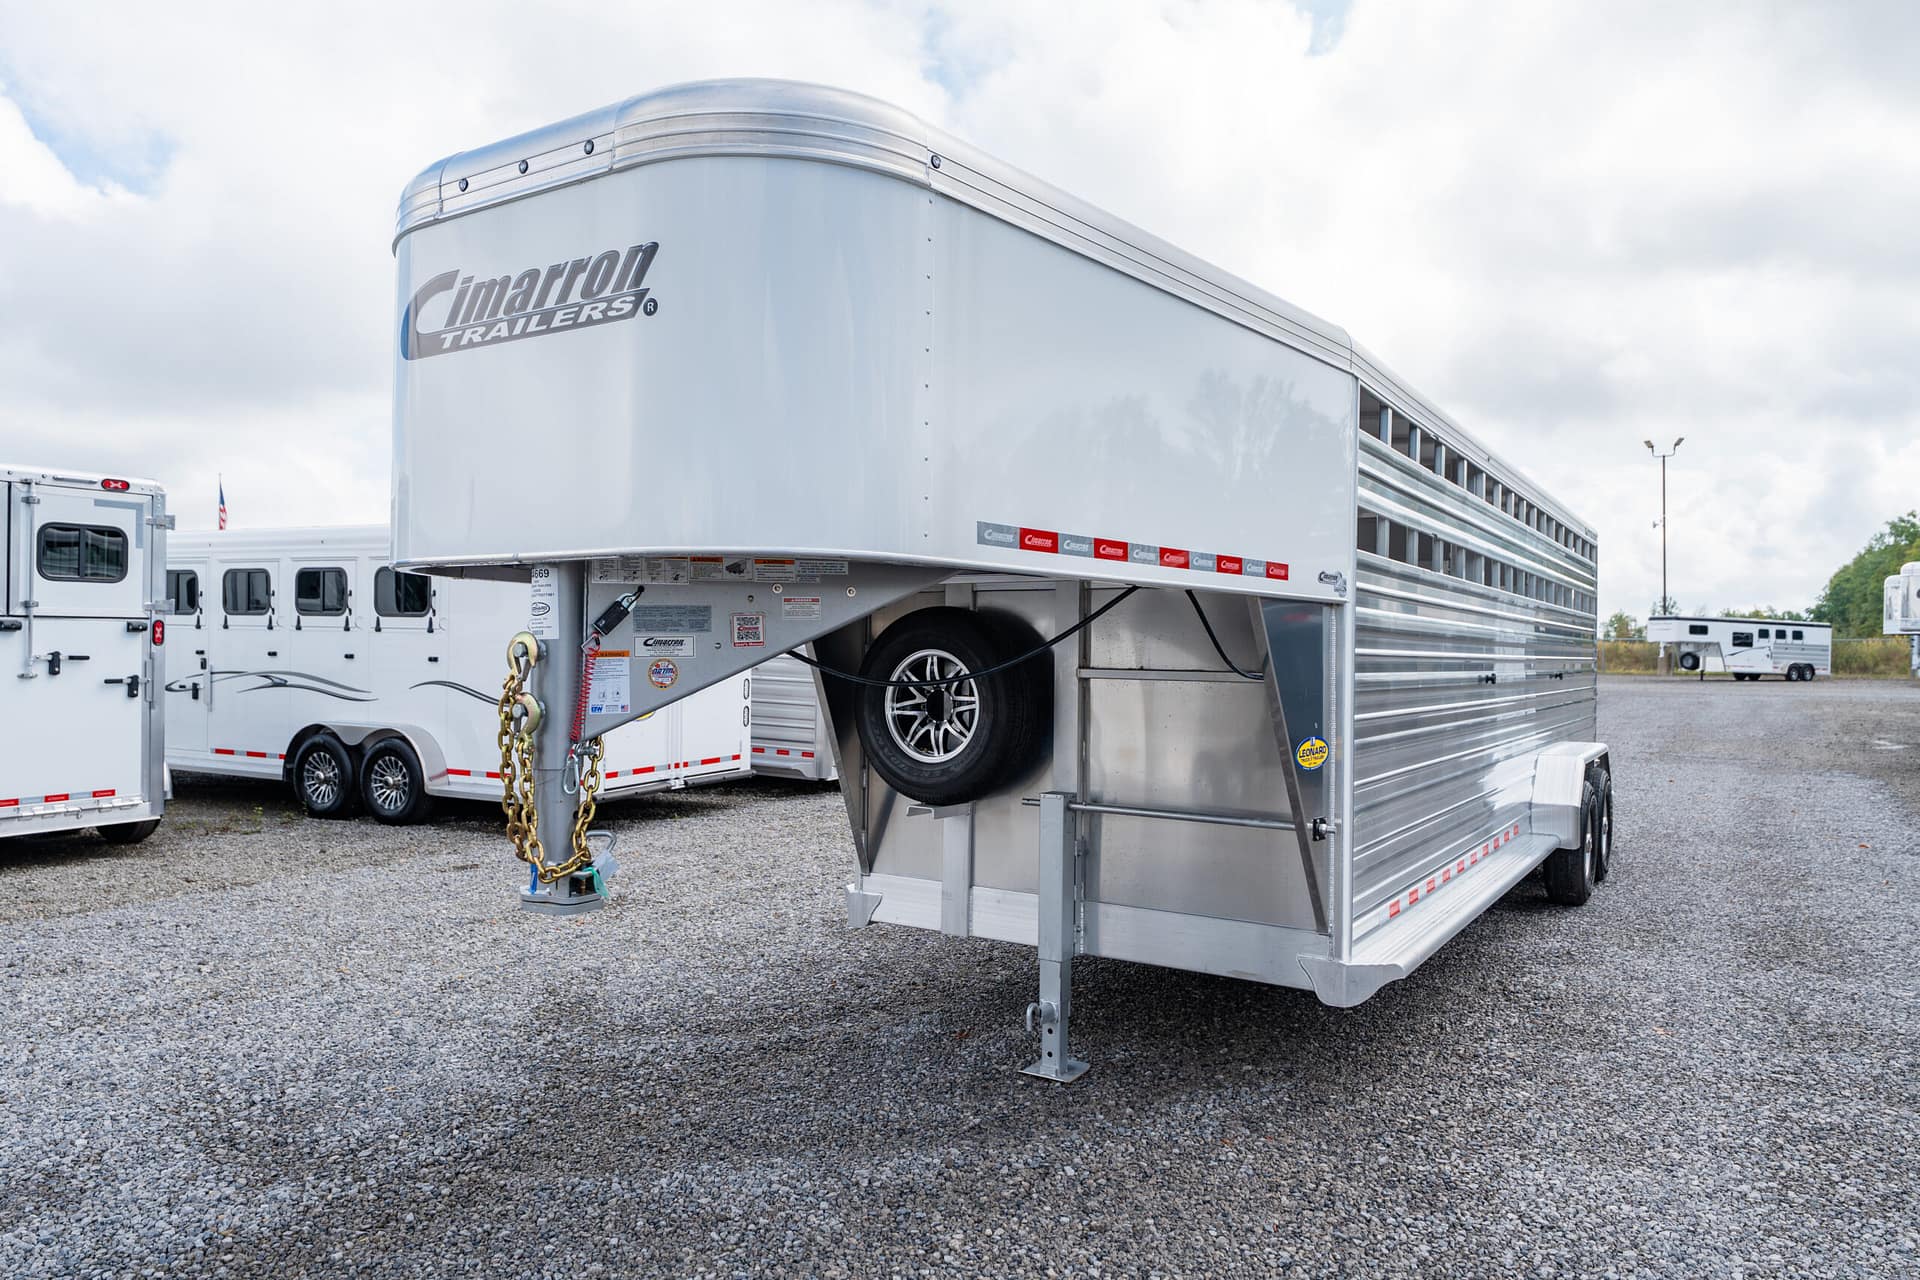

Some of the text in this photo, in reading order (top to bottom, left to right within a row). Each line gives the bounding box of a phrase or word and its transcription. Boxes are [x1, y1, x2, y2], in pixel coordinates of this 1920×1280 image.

[401, 242, 659, 348] Cimarron
[440, 295, 636, 349] TRAILERS
[1298, 746, 1326, 758] LEONARD
